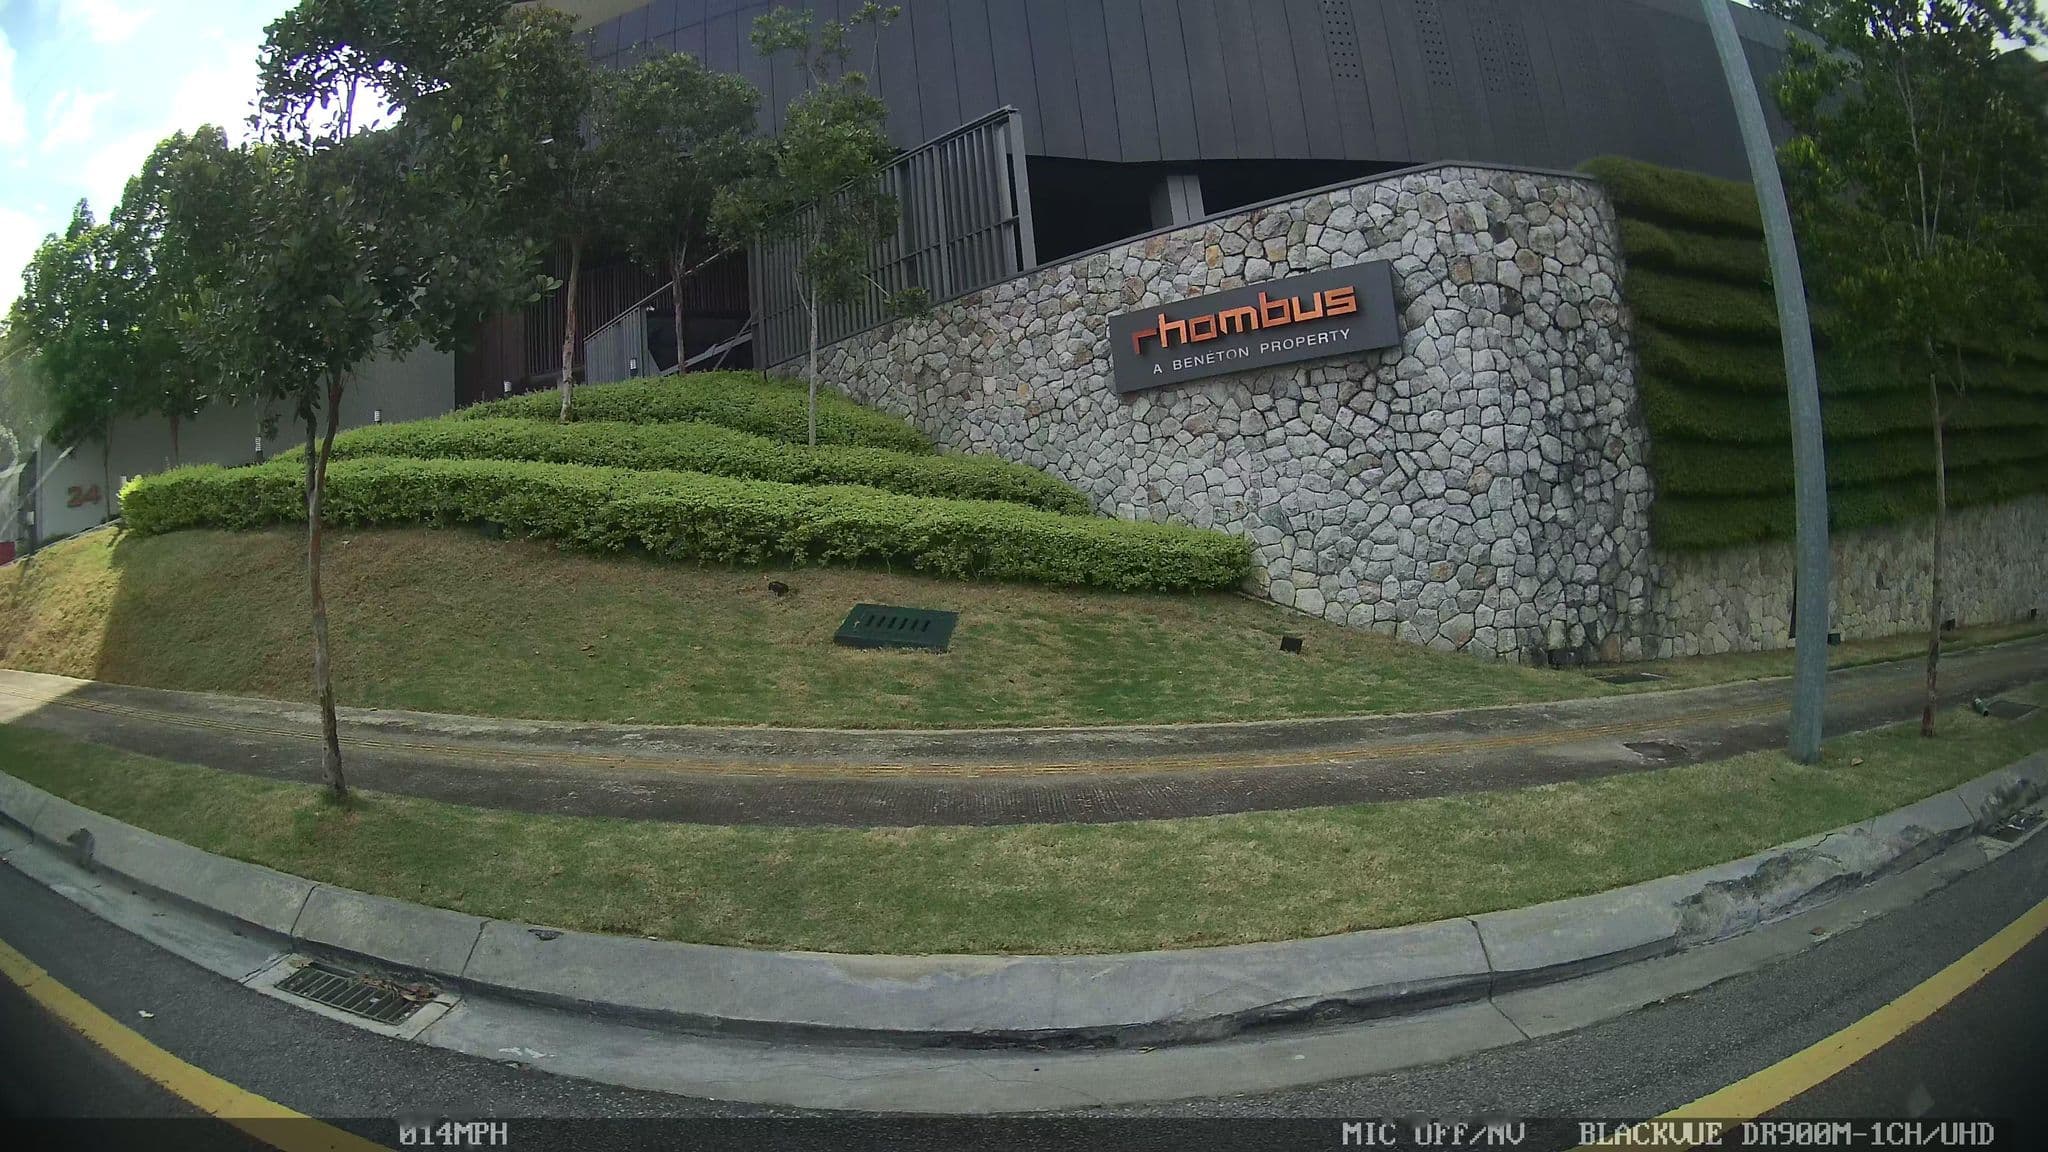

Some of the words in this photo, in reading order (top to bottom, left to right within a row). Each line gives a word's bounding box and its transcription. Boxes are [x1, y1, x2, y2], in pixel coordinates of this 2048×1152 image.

[1132, 286, 1357, 355] rhombus
[1153, 364, 1163, 375] A
[1260, 328, 1351, 353] PROPERTY
[67, 485, 101, 507] 24
